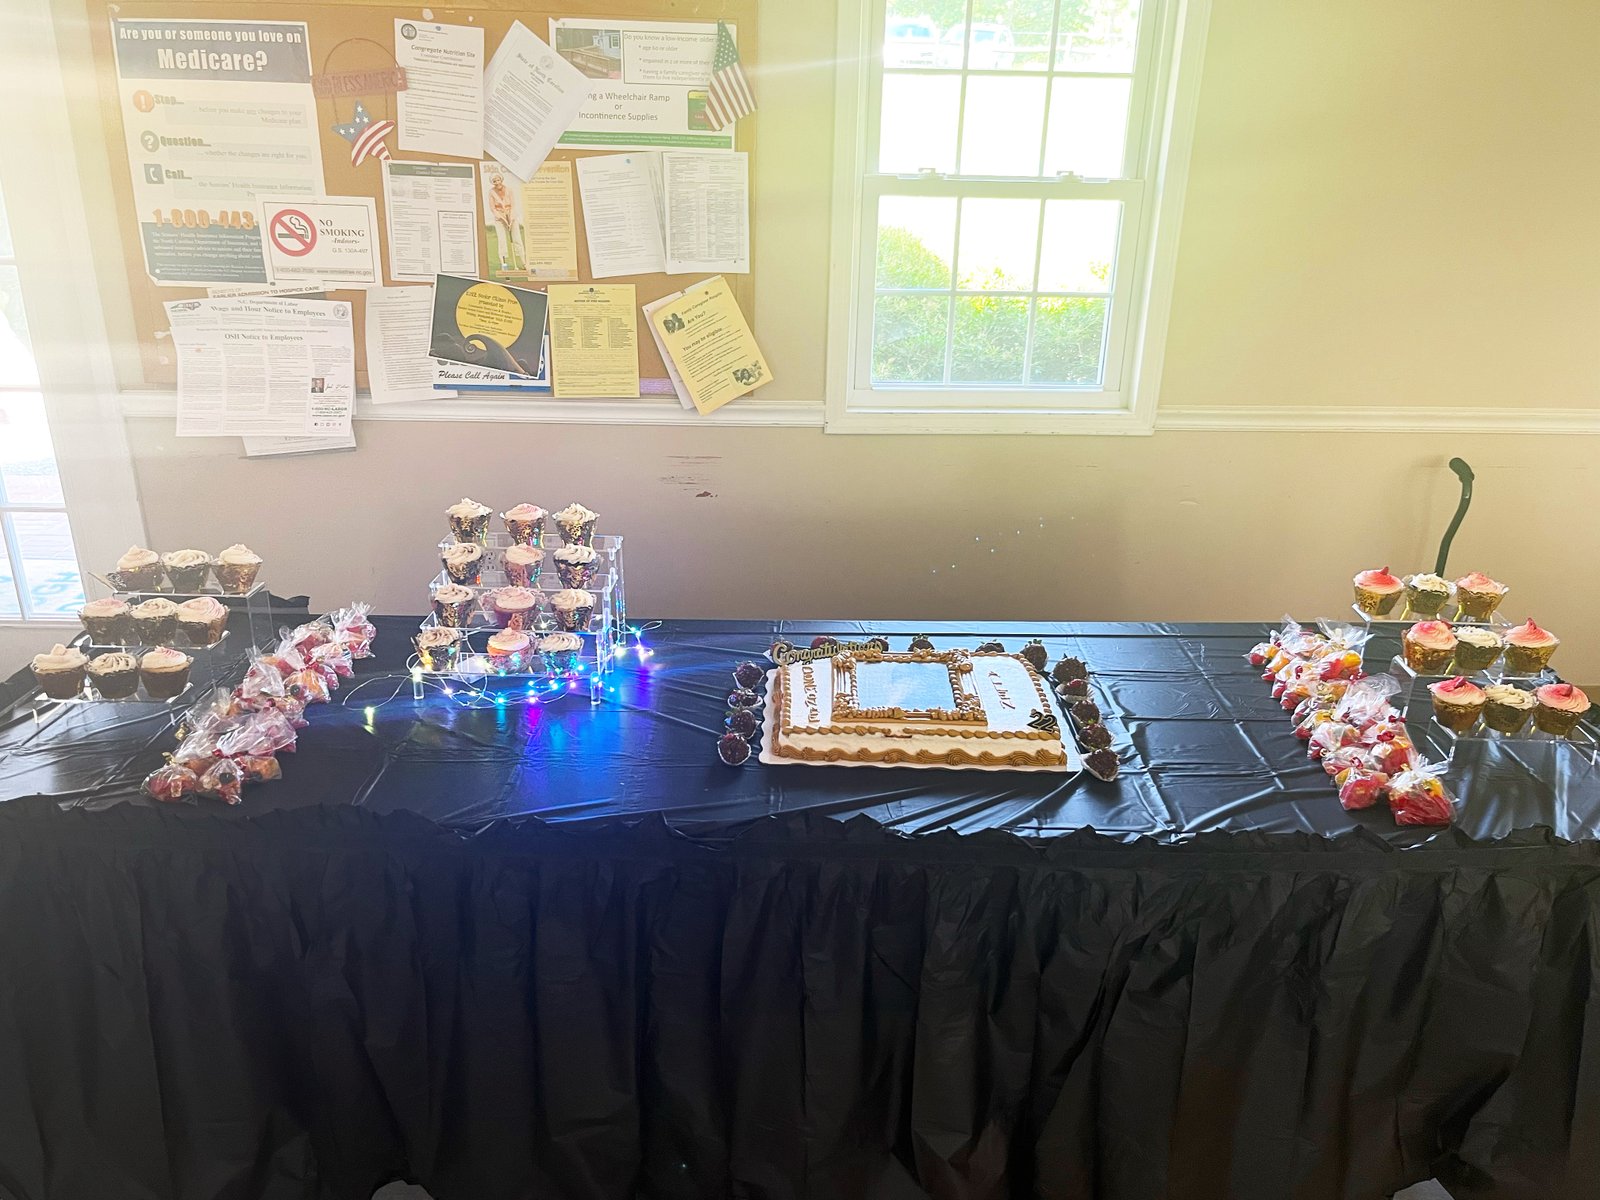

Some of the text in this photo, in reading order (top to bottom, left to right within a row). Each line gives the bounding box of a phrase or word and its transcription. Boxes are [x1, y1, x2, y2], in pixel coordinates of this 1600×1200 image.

[120, 28, 302, 45] Are you or someone you love on
[644, 34, 660, 42] know
[411, 44, 476, 59] Congregate Nutrition Site
[157, 48, 269, 74] Medicare?
[605, 92, 648, 102] Wheelchair
[649, 94, 671, 103] Ramp
[578, 111, 659, 122] Incontinence Supplies
[153, 207, 259, 231] 1-800-443-
[319, 218, 333, 227] NO
[320, 228, 366, 238] SMOKING
[270, 288, 280, 296] TO
[280, 286, 304, 295] HOSPICE
[304, 284, 321, 292] CARE
[231, 304, 243, 312] and
[263, 305, 284, 314] Notice
[284, 307, 292, 315] to
[292, 307, 327, 317] Employees
[241, 332, 260, 341] Notice
[261, 333, 269, 341] to
[269, 334, 304, 343] Employees
[438, 370, 507, 382] Please Call Again
[1026, 708, 1058, 735] 22
